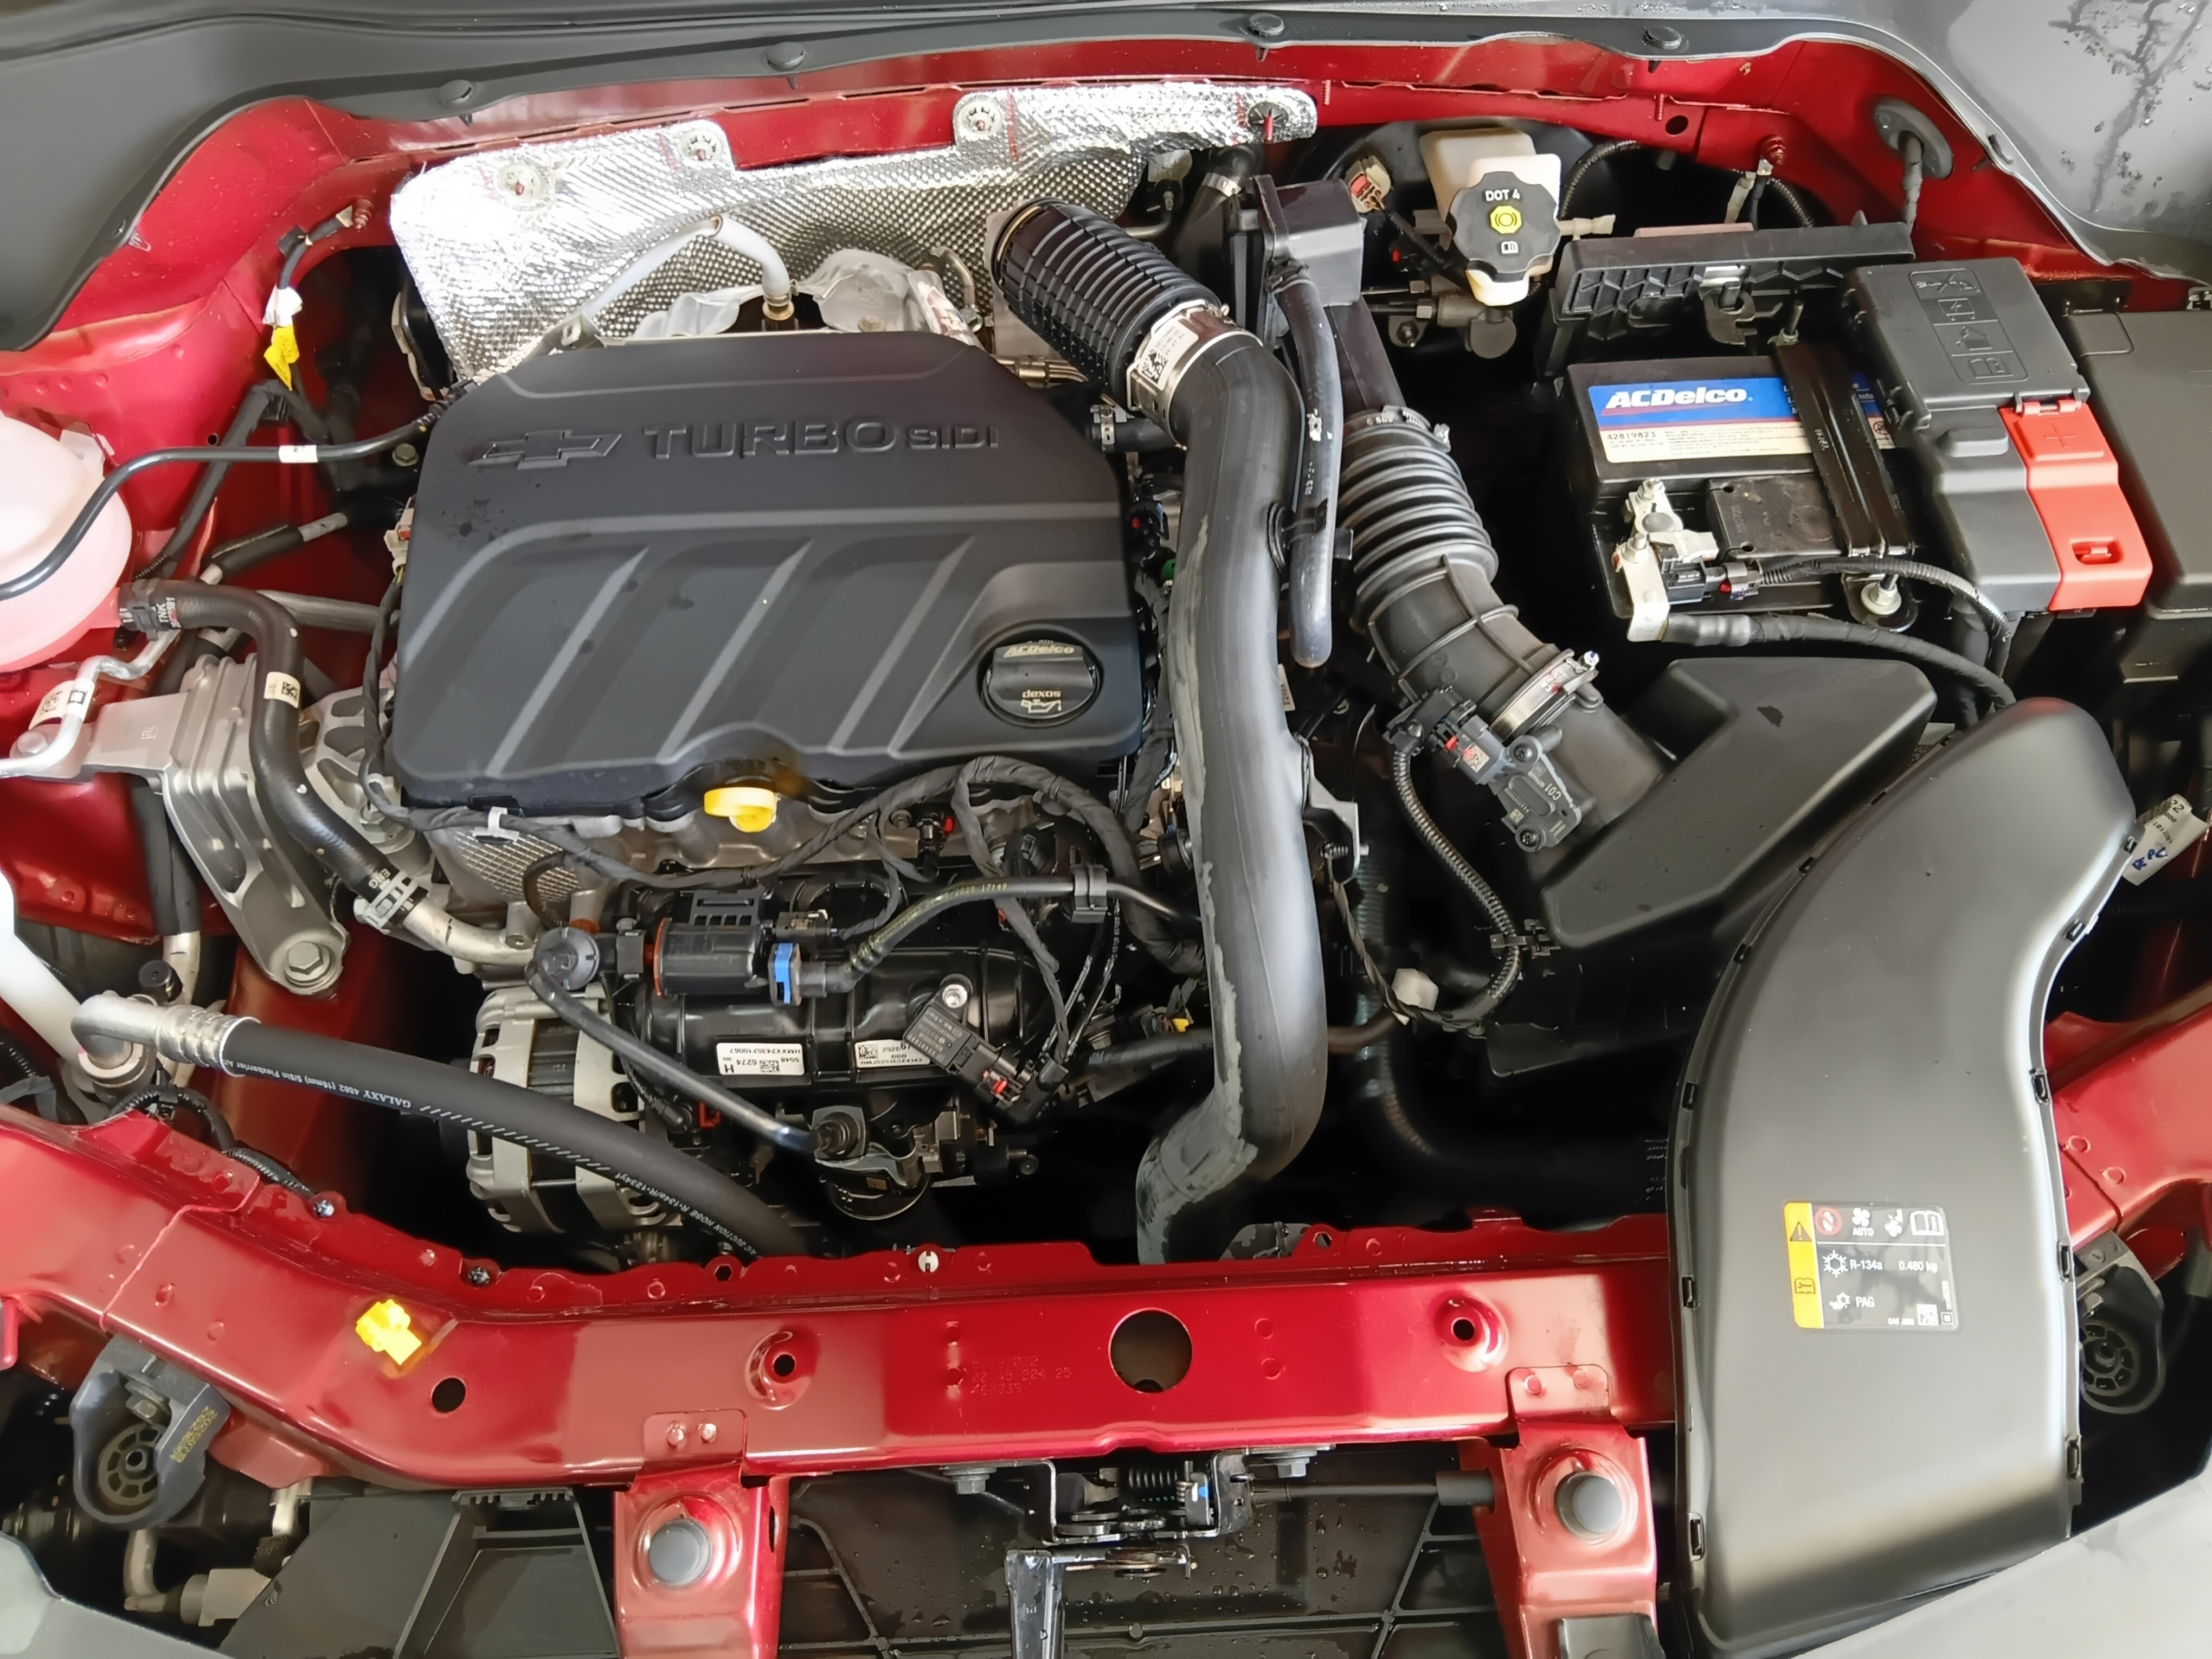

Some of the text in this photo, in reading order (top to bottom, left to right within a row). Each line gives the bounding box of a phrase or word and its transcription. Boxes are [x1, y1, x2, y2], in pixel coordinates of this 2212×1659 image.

[1485, 189, 1520, 201] DOT 4
[1605, 387, 1747, 409] ACDelco
[644, 419, 999, 460] TURBO SIDI
[1607, 430, 1656, 441] 42819823
[1003, 645, 1075, 658] ACDelco
[1022, 689, 1062, 698] dexos
[368, 868, 391, 889] ENG
[236, 1060, 280, 1079] Flexbarrier
[363, 1089, 411, 1109] GALAXY
[689, 1208, 714, 1228] HOSE
[714, 1223, 746, 1248] SUCTION
[1852, 1227, 1874, 1237] AUTO
[1849, 1259, 1938, 1274] R-134a 0.480 kg
[1855, 1296, 1876, 1308] PAG
